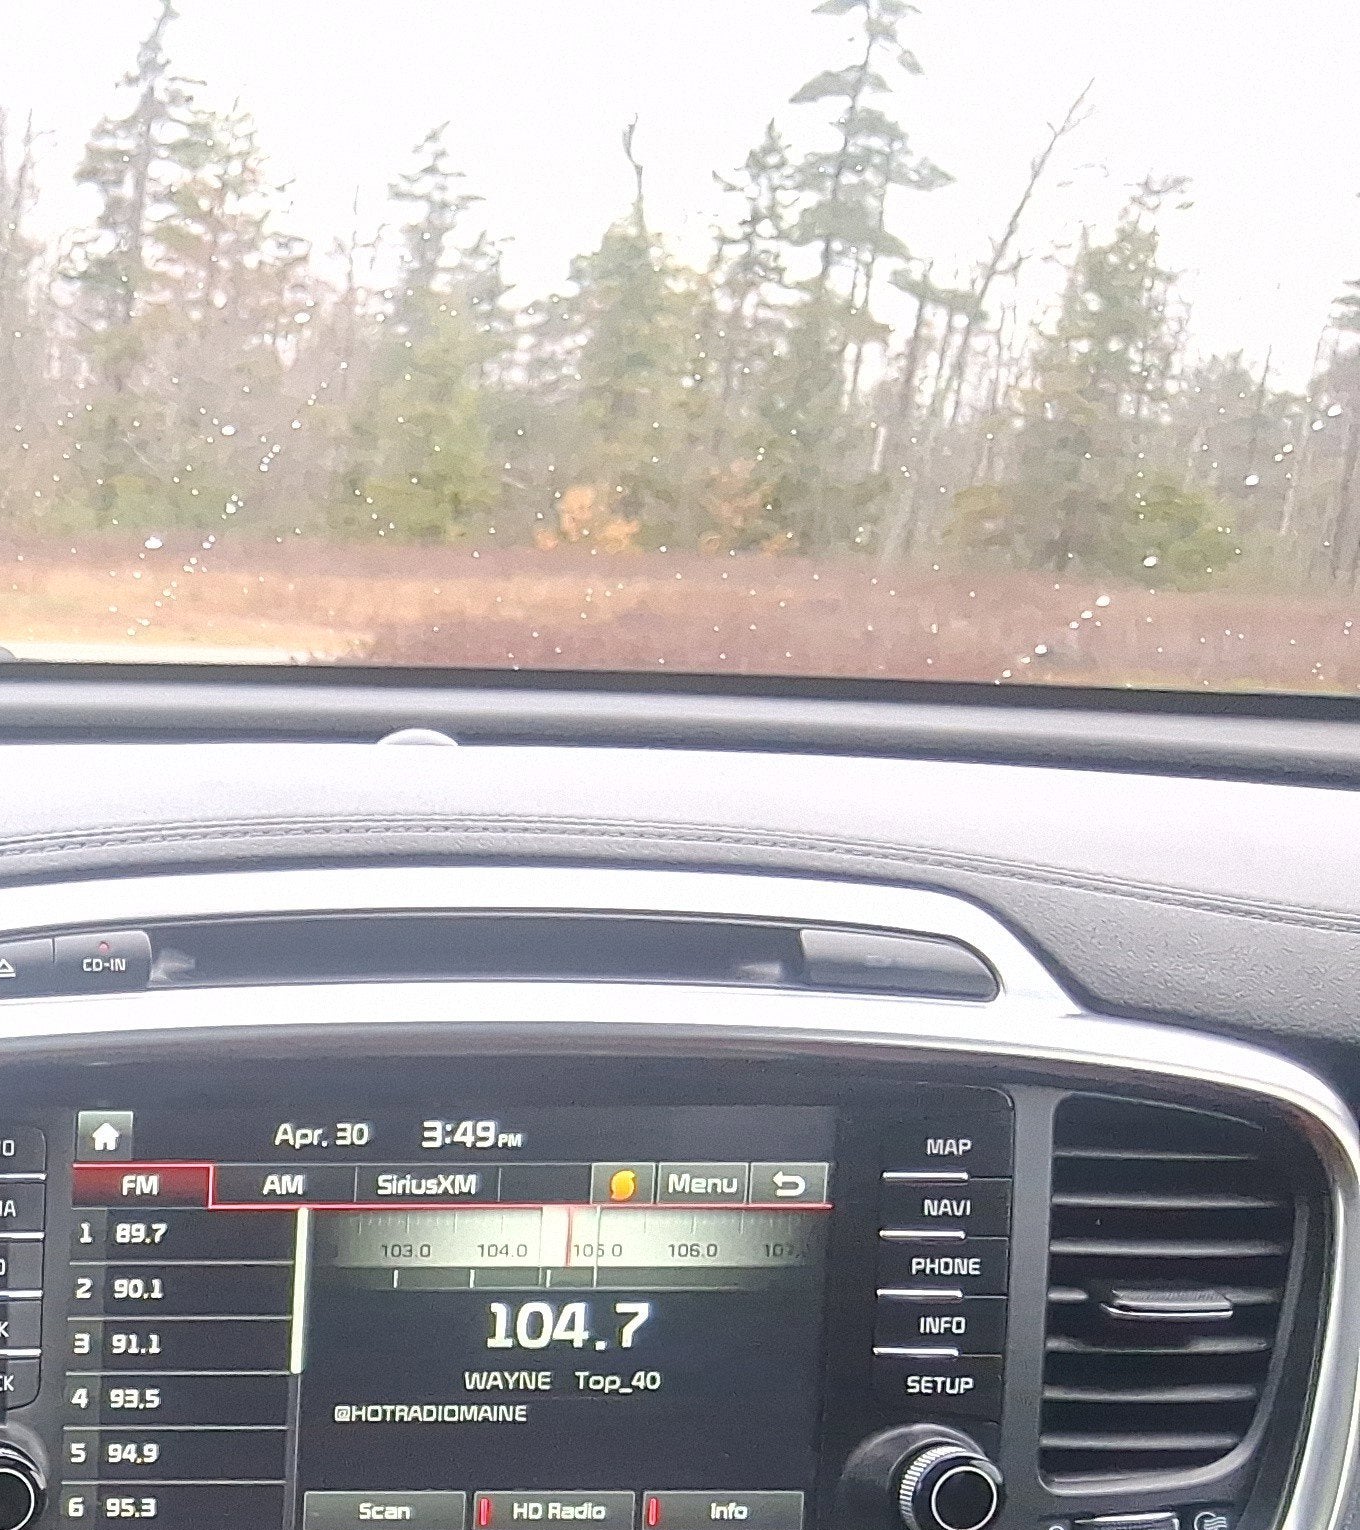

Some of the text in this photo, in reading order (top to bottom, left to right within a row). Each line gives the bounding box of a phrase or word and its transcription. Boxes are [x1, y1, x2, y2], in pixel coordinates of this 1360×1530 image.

[83, 958, 126, 973] CD-IN
[274, 1122, 328, 1149] Apr.
[335, 1122, 369, 1146] 30
[926, 1138, 972, 1156] MAP
[121, 1174, 160, 1196] FM
[262, 1174, 305, 1196] AM
[377, 1173, 478, 1196] SiriusXM
[668, 1173, 739, 1195] Menu
[923, 1199, 971, 1217] NAVI
[79, 1223, 168, 1244] 1 89.7
[381, 1243, 431, 1258] 103.0
[477, 1243, 528, 1258] 104.0
[667, 1243, 718, 1258] 106.0
[911, 1258, 981, 1276] PHONE
[76, 1278, 164, 1300] 2 90.1
[486, 1301, 651, 1351] 104.7
[919, 1317, 967, 1334] INFO
[73, 1334, 162, 1355] 3 91.1
[464, 1371, 661, 1395] WAYNE Top_40
[906, 1376, 974, 1395] SETUP
[70, 1388, 161, 1409] 4 93.5
[334, 1405, 528, 1423] @HOTRADIOMAINE
[70, 1443, 160, 1464] 5 94.9
[68, 1498, 157, 1518] 6 95.3
[358, 1502, 412, 1520] Scan
[512, 1502, 606, 1520] HD Radio
[710, 1502, 749, 1520] Info
